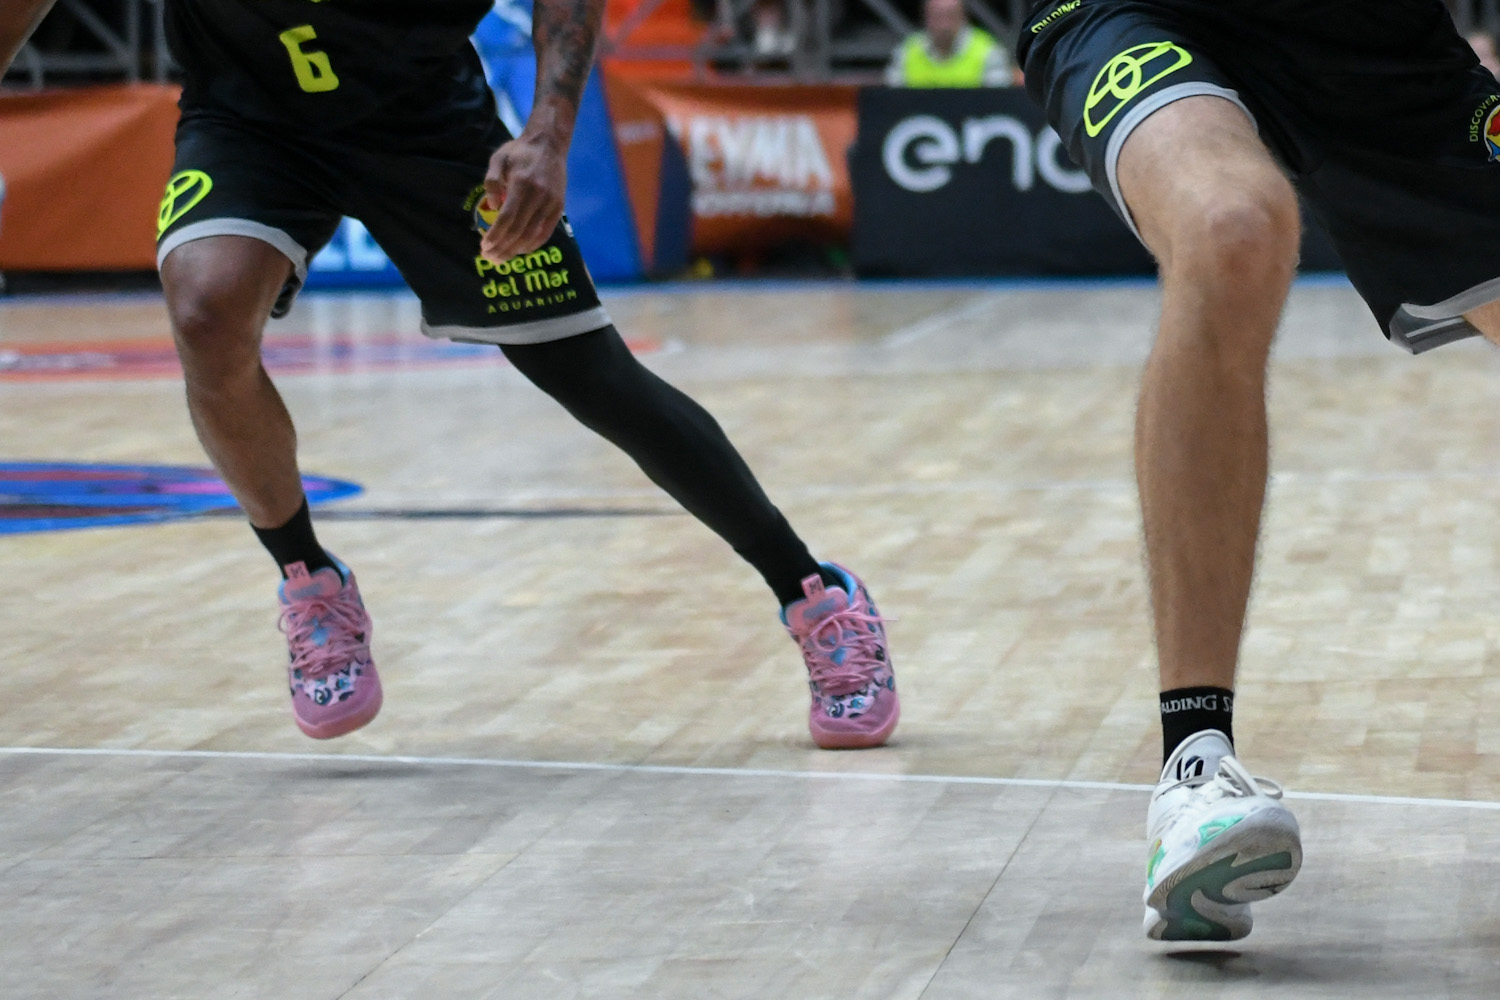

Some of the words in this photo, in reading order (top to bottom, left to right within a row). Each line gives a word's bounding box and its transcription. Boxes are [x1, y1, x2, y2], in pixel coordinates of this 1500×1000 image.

[279, 24, 340, 94] 6
[475, 246, 563, 278] Poema
[482, 275, 520, 299] del
[524, 269, 569, 293] Mar
[488, 290, 577, 314] AQUARIUM
[1160, 694, 1217, 714] ALDING
